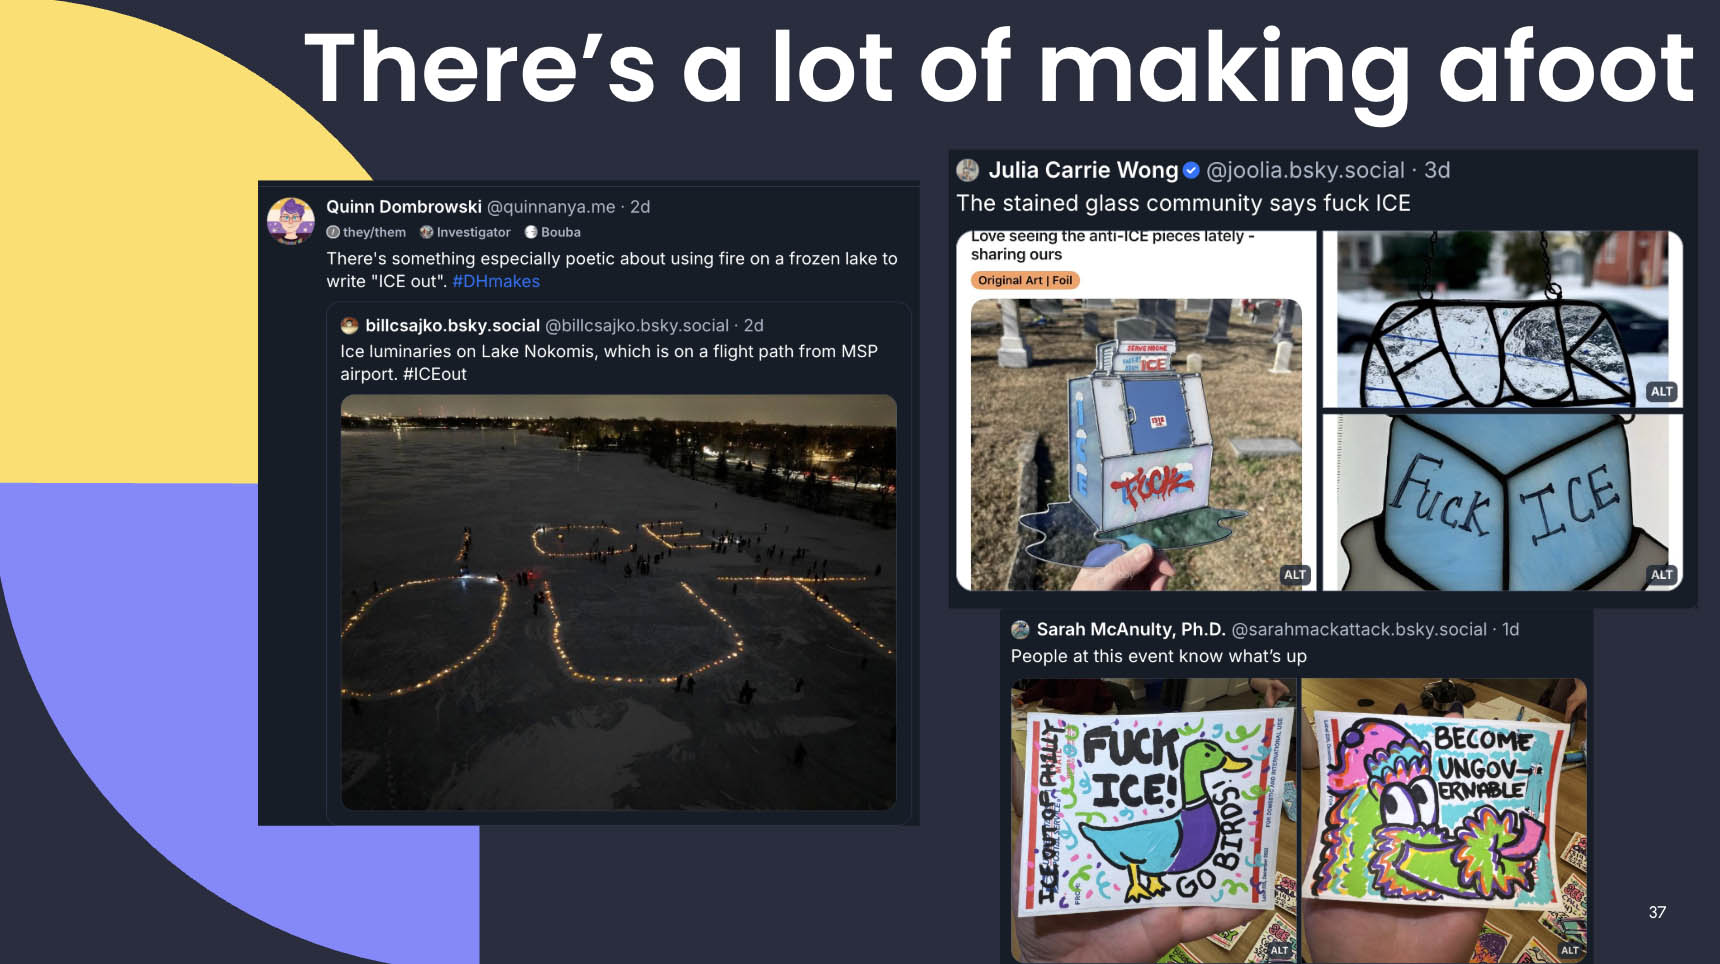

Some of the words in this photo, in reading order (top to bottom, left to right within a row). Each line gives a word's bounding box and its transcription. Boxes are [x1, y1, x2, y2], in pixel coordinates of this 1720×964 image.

[304, 29, 654, 102] There’s
[684, 47, 740, 102] a
[776, 29, 892, 102] lot
[921, 26, 1011, 102] of
[1042, 25, 1408, 127] making
[1440, 26, 1693, 102] afoot
[989, 161, 1038, 178] Julia
[1046, 161, 1110, 178] Carrie
[1117, 161, 1178, 183] Wong
[1207, 161, 1404, 182] @joolia.bsky.social
[1425, 161, 1450, 178] 3d
[327, 200, 374, 214] Quinn
[380, 200, 481, 213] Dombrowski
[488, 200, 615, 216] @quinnanya.me
[631, 200, 650, 213] 2d
[956, 194, 995, 211] The
[1004, 194, 1078, 211] stained
[1086, 194, 1139, 216] glass
[1147, 194, 1262, 216] community
[1270, 198, 1316, 216] says
[1323, 193, 1369, 211] fuck
[1377, 194, 1410, 211] ICE
[343, 227, 406, 239] they/them
[438, 227, 511, 239] Investigator
[542, 227, 580, 237] Bouba
[971, 231, 1005, 242] Love
[1010, 232, 1057, 244] seeing
[1062, 231, 1085, 241] the
[1090, 231, 1148, 241] anti-ICE
[1153, 232, 1200, 244] pieces
[1205, 231, 1244, 244] lately
[327, 252, 386, 265] There's
[392, 252, 475, 268] something
[481, 251, 560, 268] especially
[566, 252, 614, 268] poetic
[620, 252, 665, 265] about
[671, 252, 713, 268] using
[719, 251, 744, 265] fire
[750, 255, 769, 265] on
[776, 255, 784, 265] a
[789, 251, 839, 265] frozen
[846, 252, 877, 265] lake
[882, 253, 897, 265] to
[972, 248, 1025, 263] sharing
[1030, 251, 1062, 260] ours
[327, 274, 365, 287] write
[372, 274, 405, 287] "ICE
[411, 274, 446, 288] out".
[453, 274, 540, 288] #DHmakes
[978, 276, 1022, 287] Original
[1026, 276, 1043, 285] Art
[1053, 276, 1073, 285] Foil
[366, 318, 539, 335] billcsajko.bsky.social
[546, 319, 728, 335] @billcsajko.bsky.social
[745, 319, 763, 332] 2d
[342, 344, 364, 358] Ice
[370, 344, 451, 358] luminaries
[457, 348, 475, 358] on
[482, 344, 519, 358] Lake
[525, 344, 597, 360] Nokomis,
[604, 344, 650, 358] which
[657, 344, 669, 358] is
[675, 348, 693, 358] on
[700, 348, 707, 358] a
[713, 344, 754, 361] flight
[759, 345, 793, 361] path
[799, 344, 835, 358] from
[842, 344, 878, 358] MSP
[1141, 358, 1168, 371] ICE
[341, 367, 397, 384] airport.
[403, 367, 467, 380] #ICEout
[1651, 387, 1673, 396] ALT
[1110, 465, 1196, 511] FUCK
[1519, 464, 1620, 546] ICE
[1285, 570, 1306, 580] ALT
[1651, 569, 1673, 579] ALT
[1038, 622, 1085, 636] Sarah
[1091, 622, 1176, 639] McAnulty,
[1182, 622, 1225, 636] Ph.D.
[1232, 622, 1486, 639] @sarahmackattack.bsky.social
[1503, 622, 1519, 636] 1d
[1012, 649, 1067, 666] People
[1074, 650, 1088, 662] at
[1093, 649, 1122, 662] this
[1129, 650, 1174, 663] event
[1180, 649, 1223, 662] know
[1229, 649, 1280, 662] what’s
[1287, 652, 1307, 666] up
[1435, 726, 1533, 751] BECOME
[1083, 725, 1180, 771] FUCK
[1092, 773, 1178, 809] ICE!
[1438, 781, 1526, 801] ERNABLE
[1039, 791, 1058, 821] OF
[1041, 822, 1057, 860] OUT
[1176, 868, 1216, 897] GO
[1213, 779, 1247, 871] BIRDS!
[1039, 863, 1059, 904] ICE
[1649, 906, 1666, 918] 37
[1271, 946, 1289, 955] ALT
[1561, 946, 1580, 955] ALT
